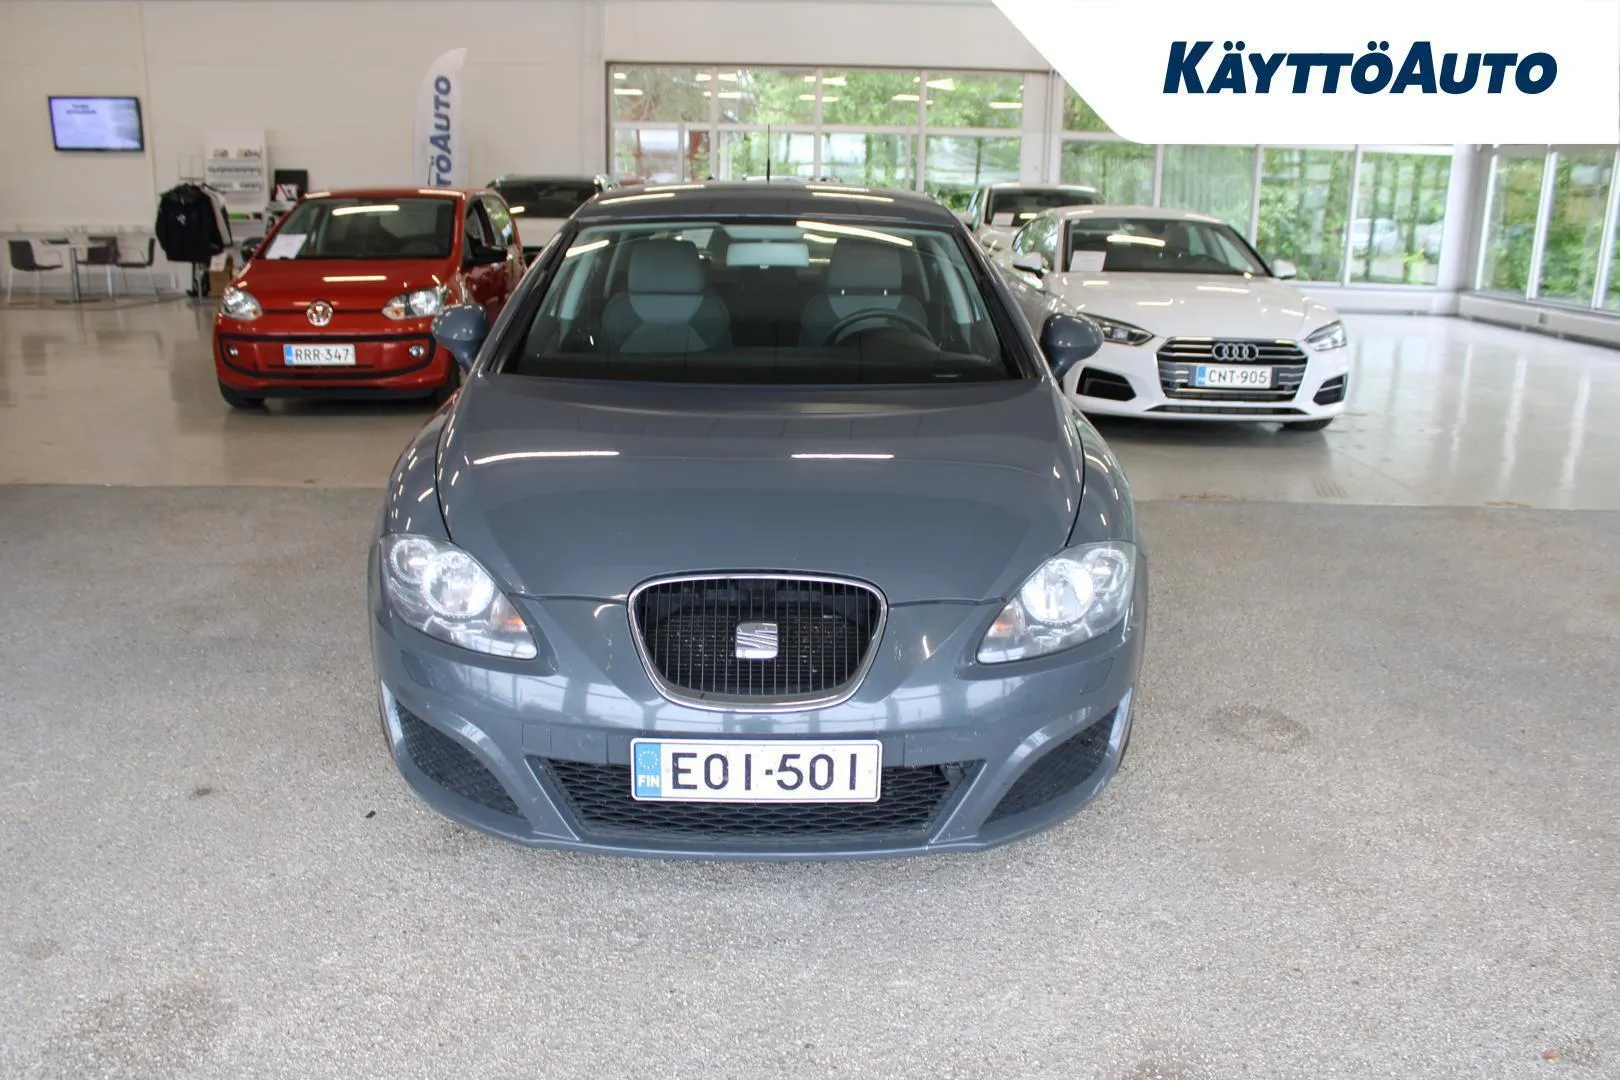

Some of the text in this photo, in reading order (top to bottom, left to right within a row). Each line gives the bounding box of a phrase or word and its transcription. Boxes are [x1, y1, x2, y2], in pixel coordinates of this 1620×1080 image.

[295, 348, 350, 361] RRR-347
[1208, 369, 1268, 384] CNT-905
[638, 774, 660, 788] FIN
